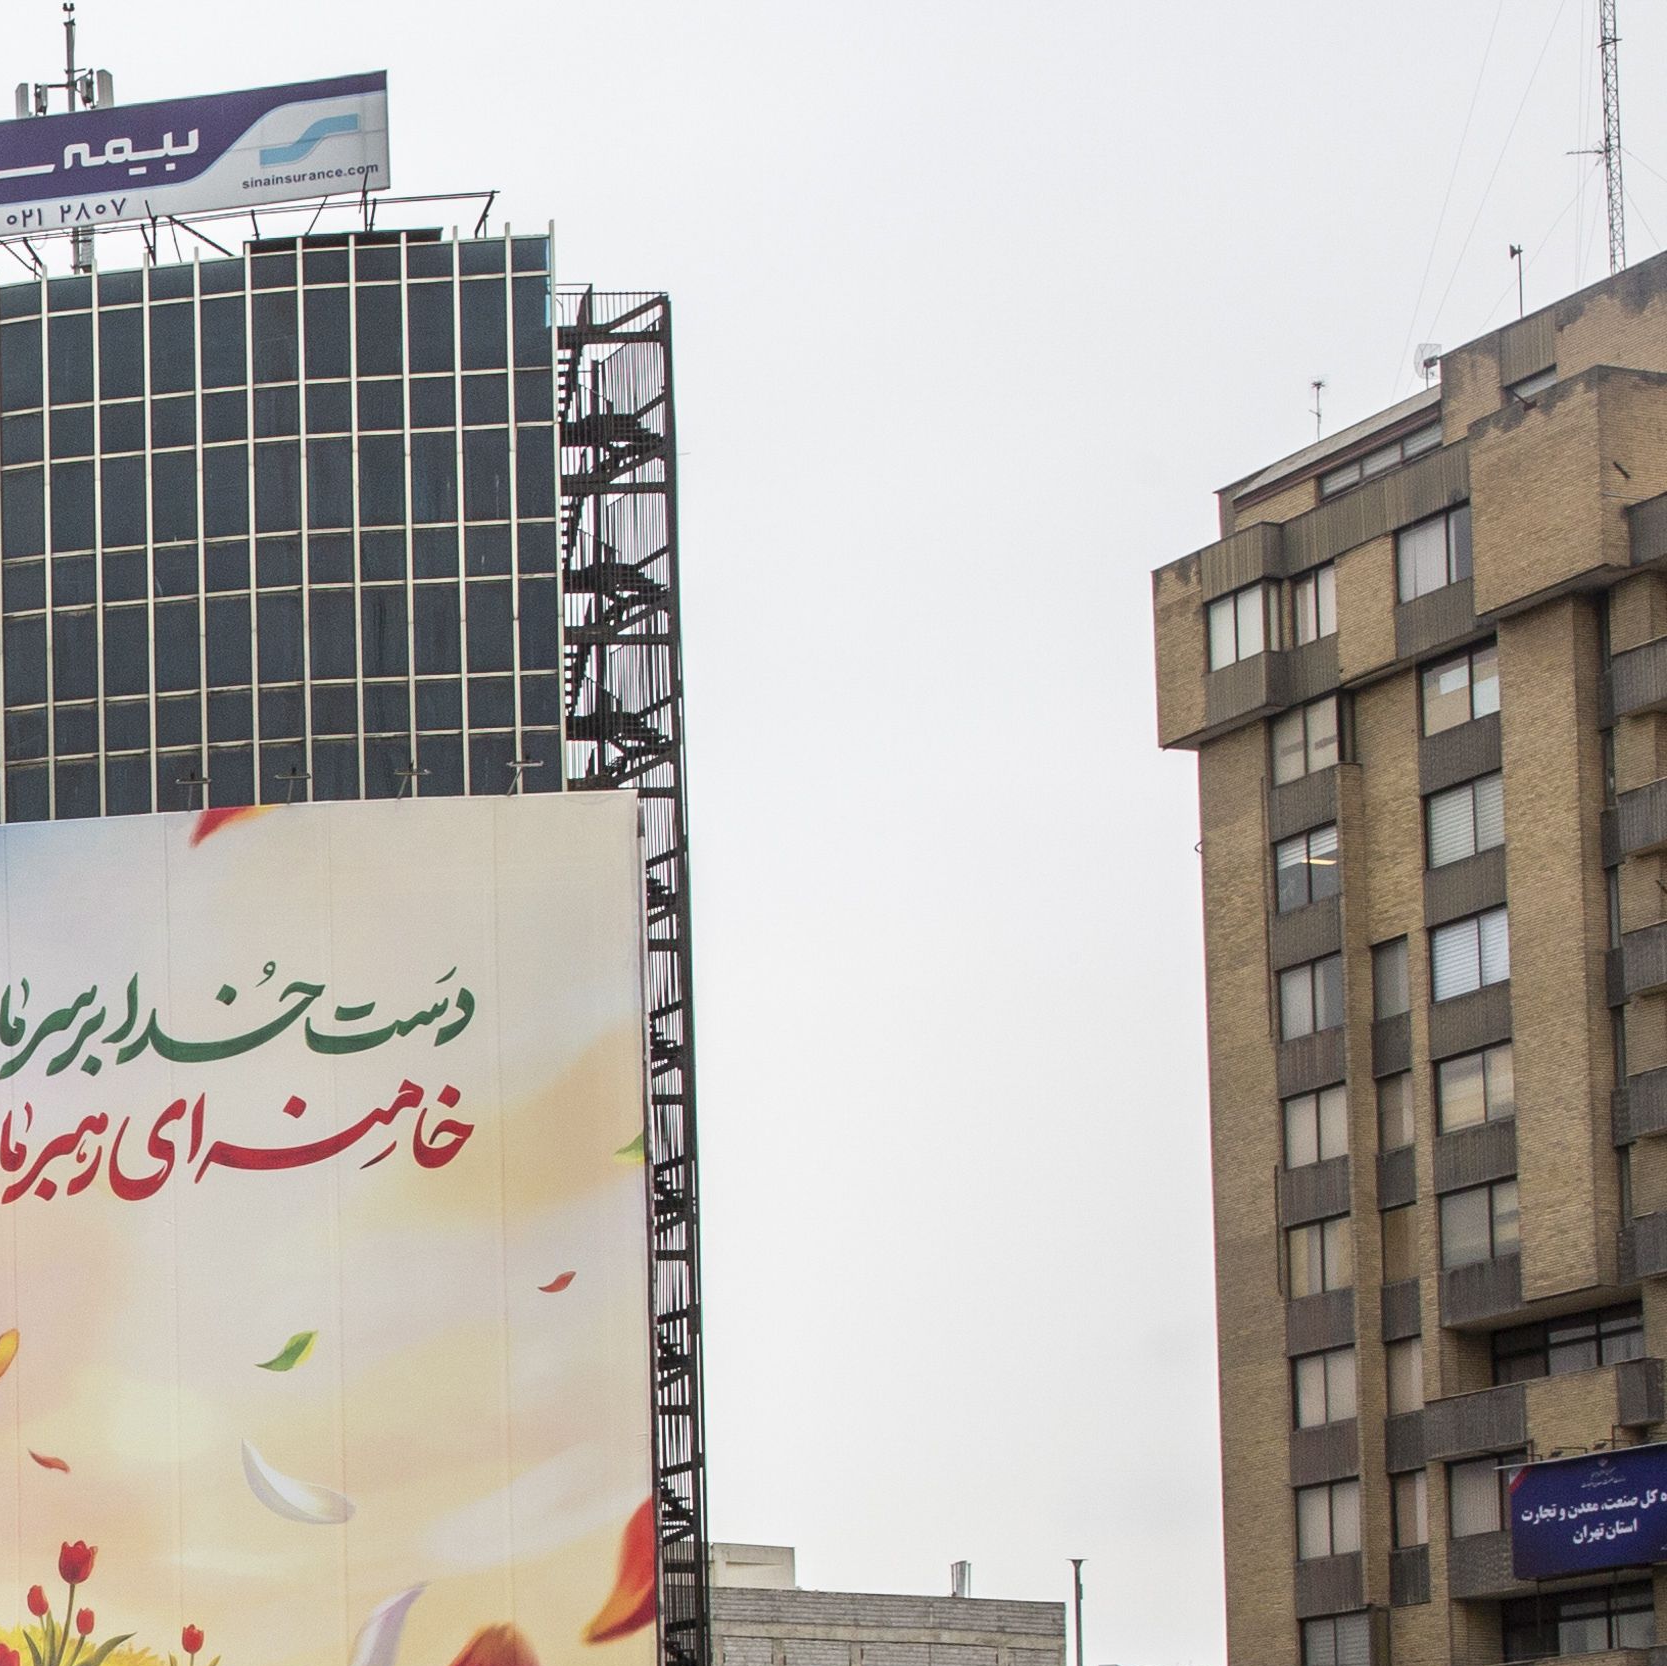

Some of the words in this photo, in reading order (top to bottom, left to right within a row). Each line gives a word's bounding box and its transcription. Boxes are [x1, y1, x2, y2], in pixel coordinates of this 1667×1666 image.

[64, 127, 199, 176] بیمه
[242, 163, 379, 190] sinainsurance.com
[1, 1111, 109, 1205] رهبر
[1639, 1489, 1659, 1509] کل
[1521, 1504, 1557, 1524] تجارت
[1558, 1509, 1566, 1521] و
[1567, 1503, 1599, 1519] معدن
[1572, 1523, 1605, 1544] تهران
[1605, 1518, 1638, 1540] استان
